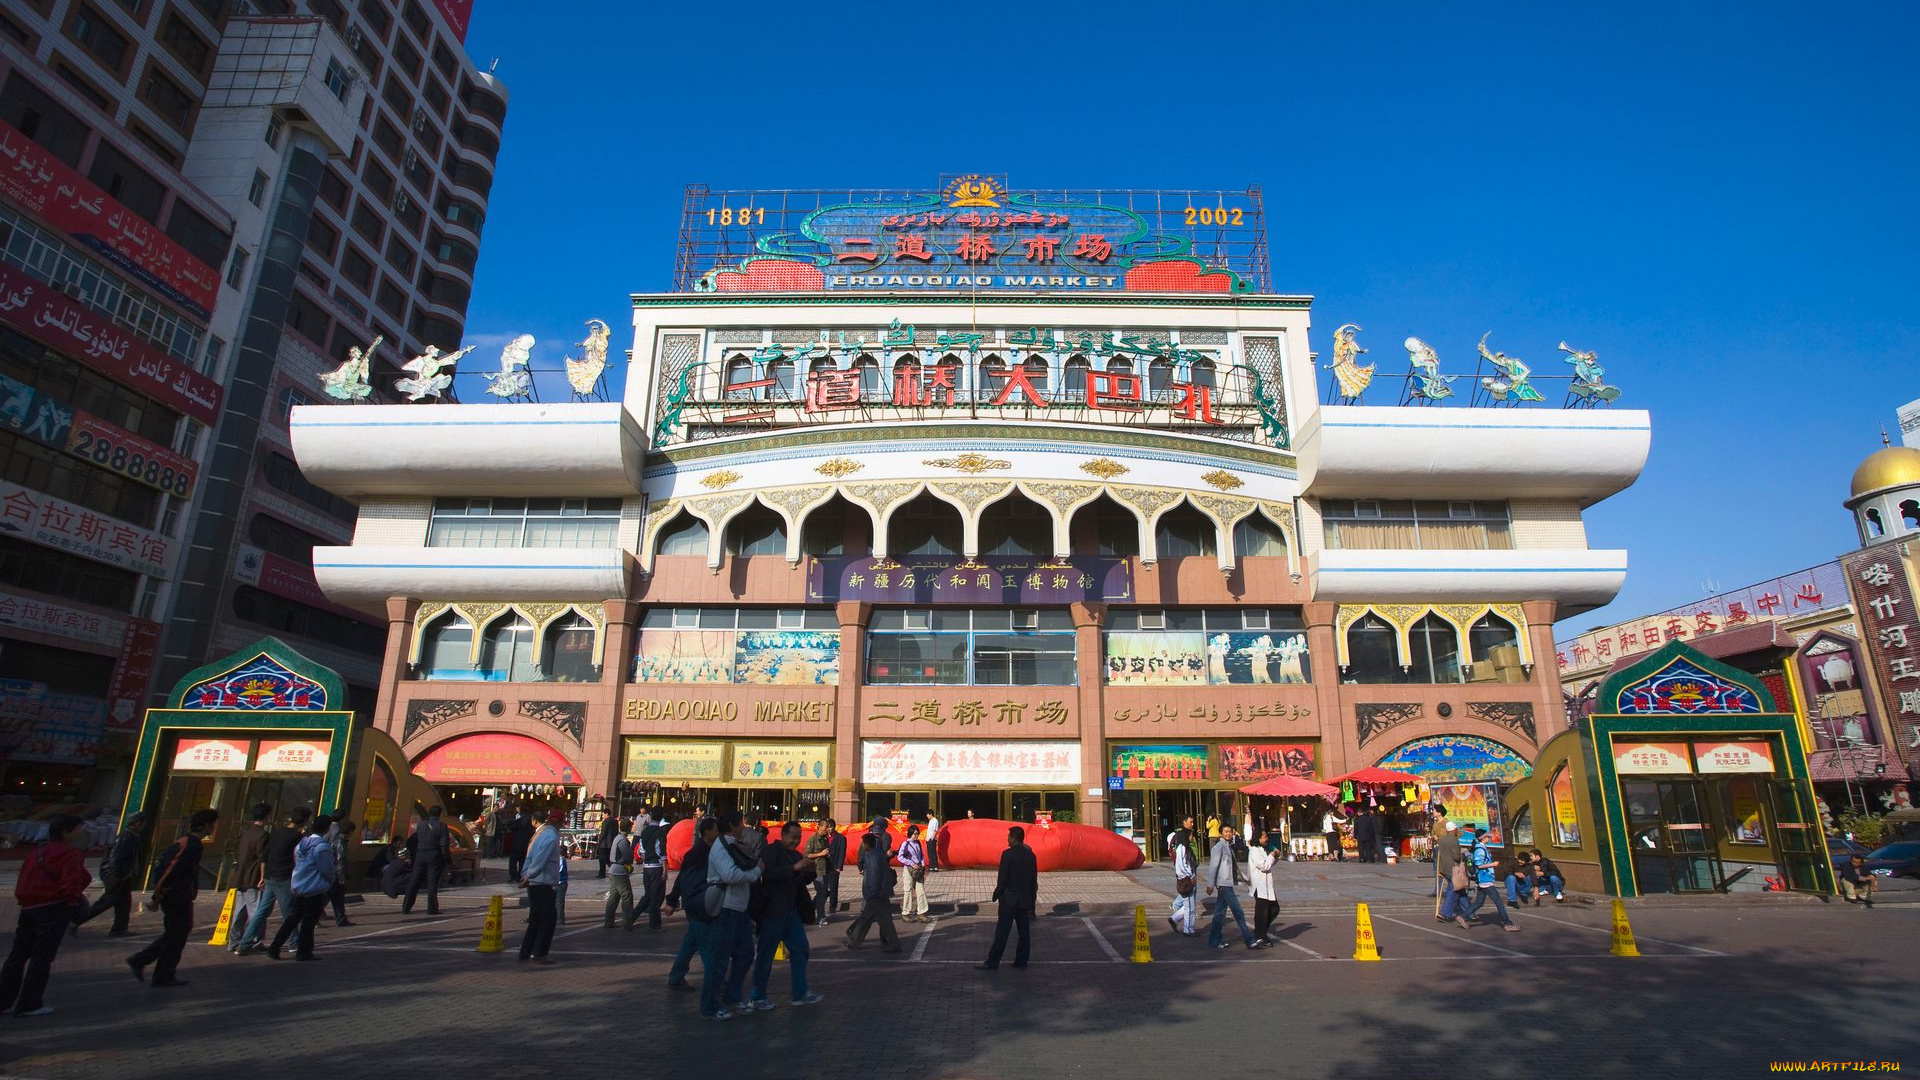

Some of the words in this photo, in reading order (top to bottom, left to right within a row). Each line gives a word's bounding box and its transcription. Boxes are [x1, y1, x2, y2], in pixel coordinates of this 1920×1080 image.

[706, 207, 765, 226] 1881
[1184, 207, 1244, 226] 2002
[837, 233, 1111, 262] 二道桥市场
[834, 275, 992, 286] ERDAOQIAO
[1005, 275, 1117, 286] MARKET
[723, 364, 1225, 425] 二道桥大巴扎
[73, 429, 190, 497] 2888888
[1861, 563, 1920, 749] 喀什河玉雕
[625, 698, 738, 721] ERDAOQIAO
[754, 700, 834, 722] MARKET
[868, 699, 1069, 726] 二道桥市场
